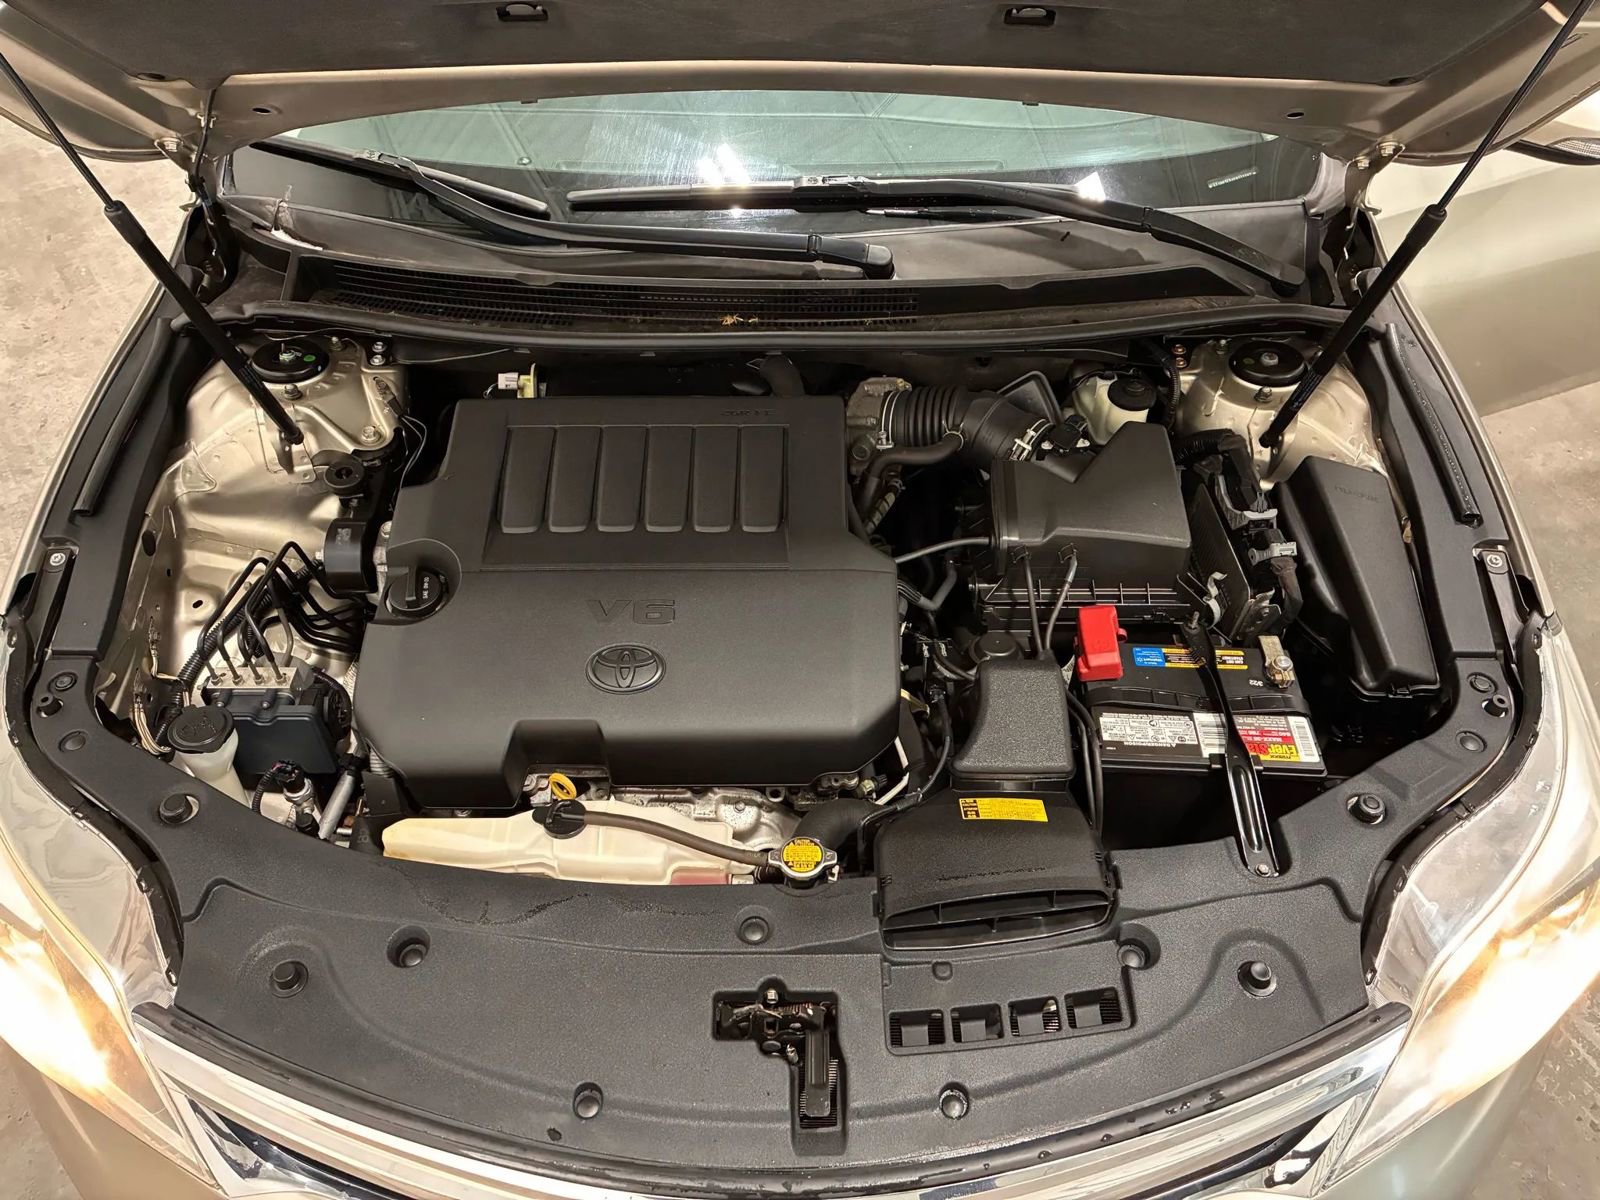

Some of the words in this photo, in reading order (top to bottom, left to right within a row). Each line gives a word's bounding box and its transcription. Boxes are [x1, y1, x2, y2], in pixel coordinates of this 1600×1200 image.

[585, 599, 676, 626] V6
[1249, 679, 1264, 687] 3/22
[1248, 744, 1297, 756] EverSta
